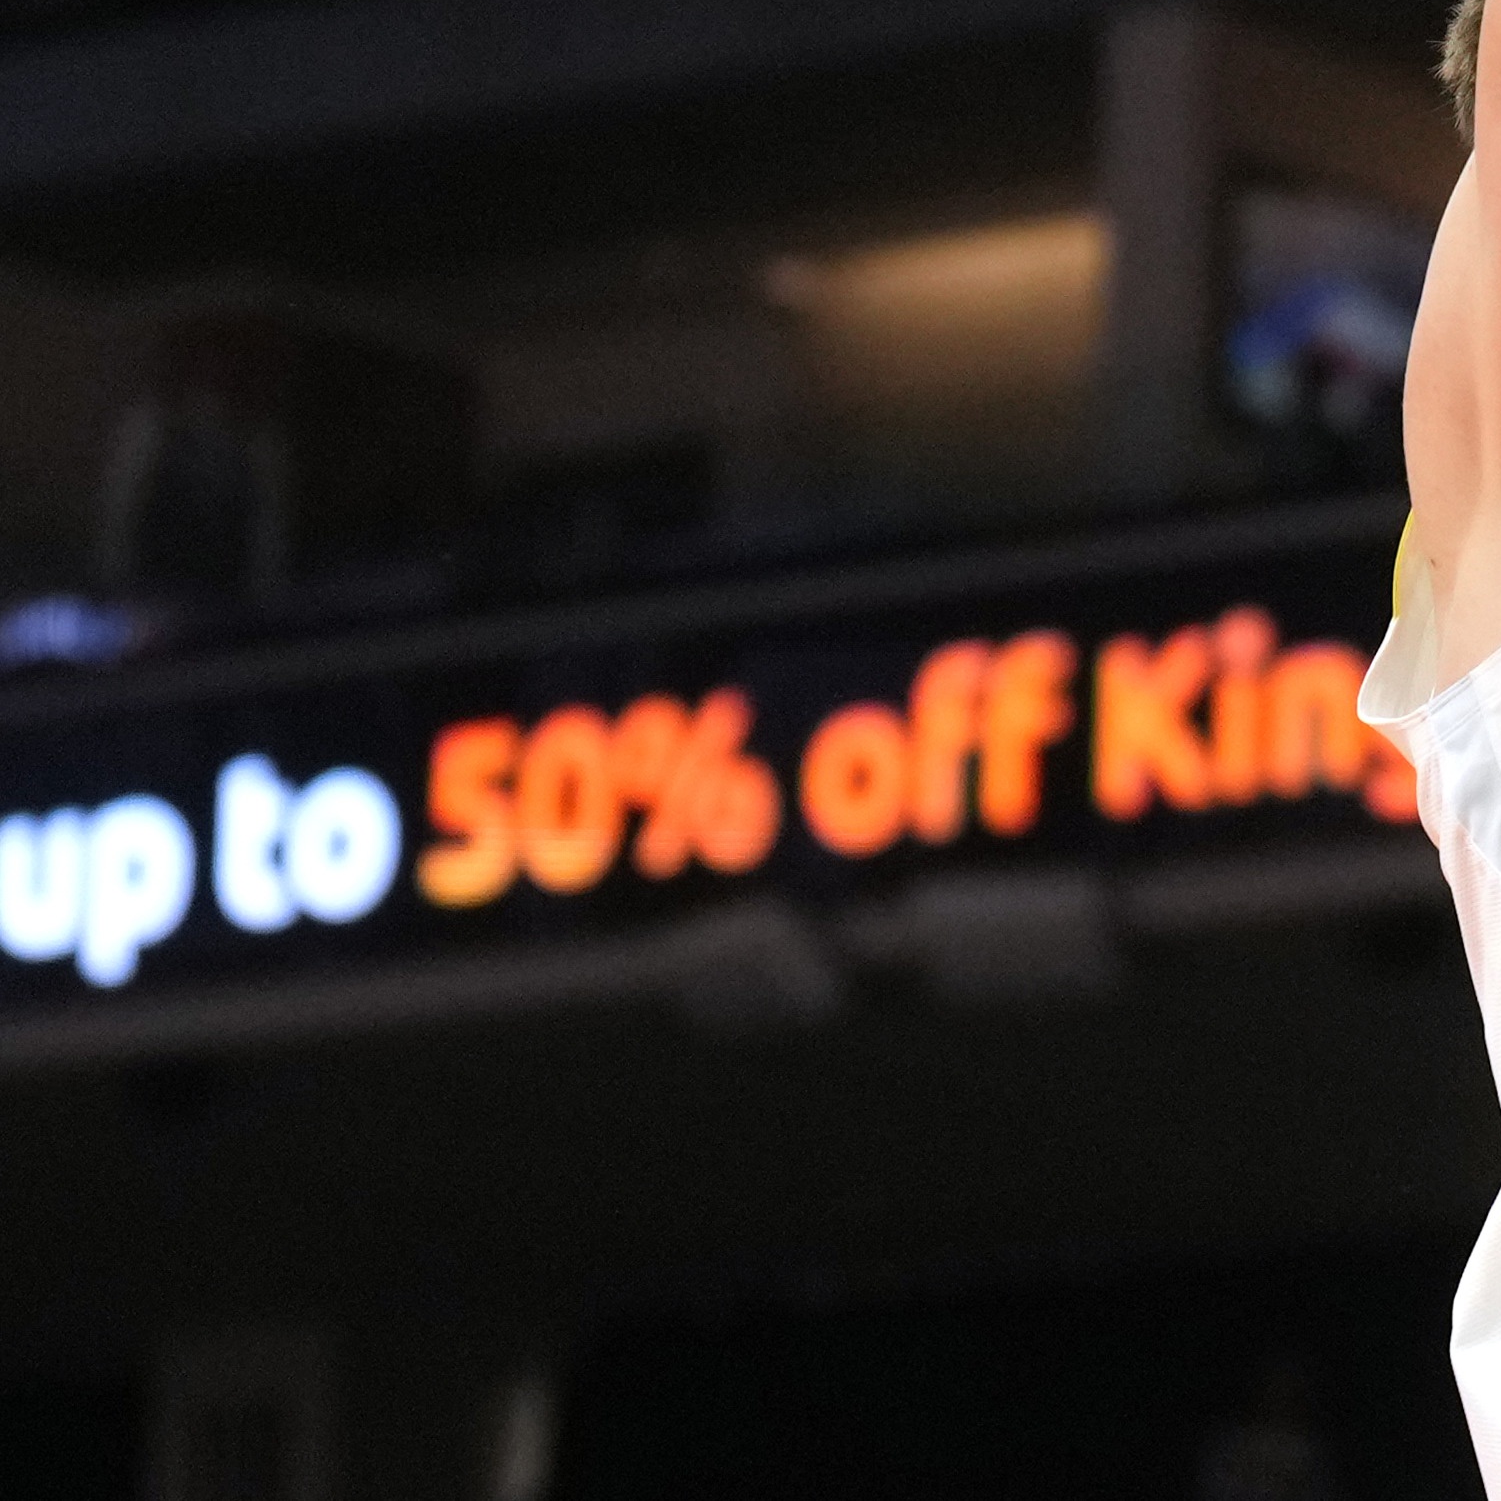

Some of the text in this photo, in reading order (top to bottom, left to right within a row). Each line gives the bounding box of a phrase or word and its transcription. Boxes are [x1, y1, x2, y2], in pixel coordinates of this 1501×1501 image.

[0, 793, 194, 987] up
[213, 753, 399, 933] to
[417, 687, 780, 908] 50%
[803, 629, 1077, 859] off
